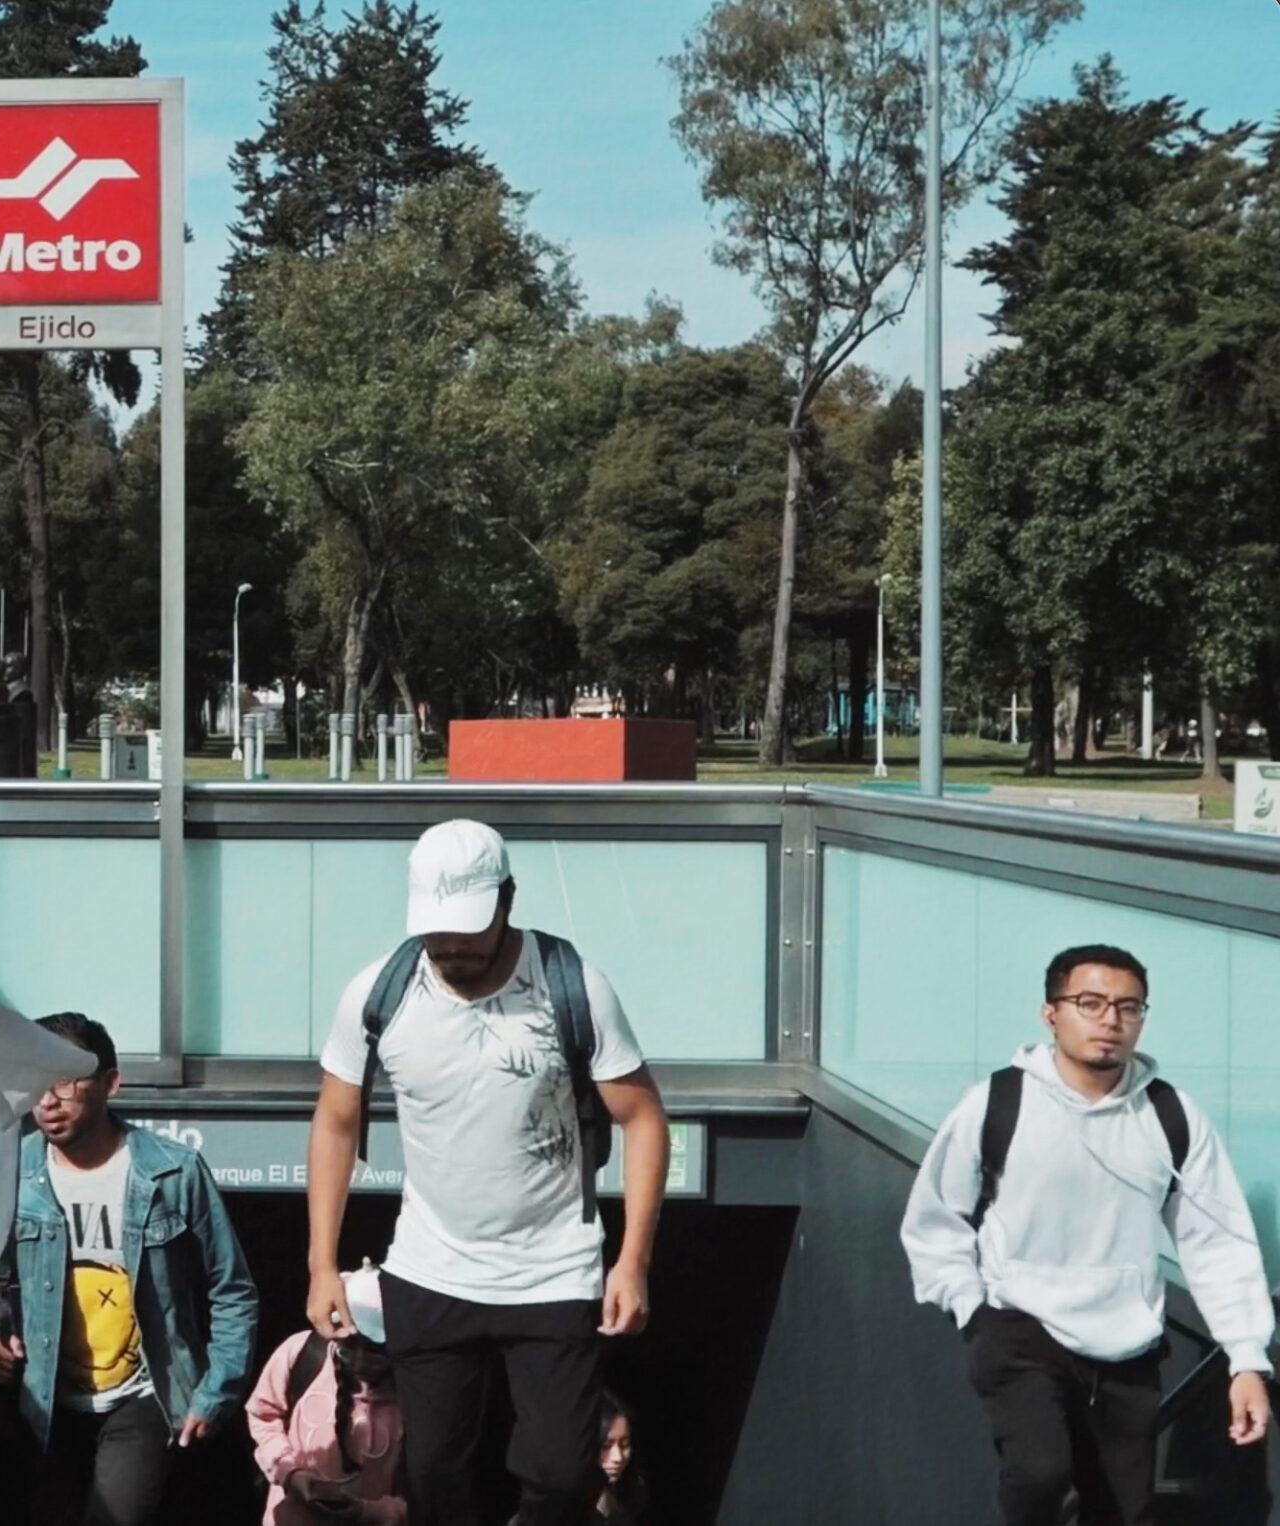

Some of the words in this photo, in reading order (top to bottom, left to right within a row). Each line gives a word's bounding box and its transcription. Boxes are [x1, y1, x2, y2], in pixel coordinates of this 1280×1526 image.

[19, 315, 96, 343] Ejido
[211, 1167, 263, 1186] arque
[269, 1165, 287, 1182] El
[71, 1202, 114, 1250] VA
